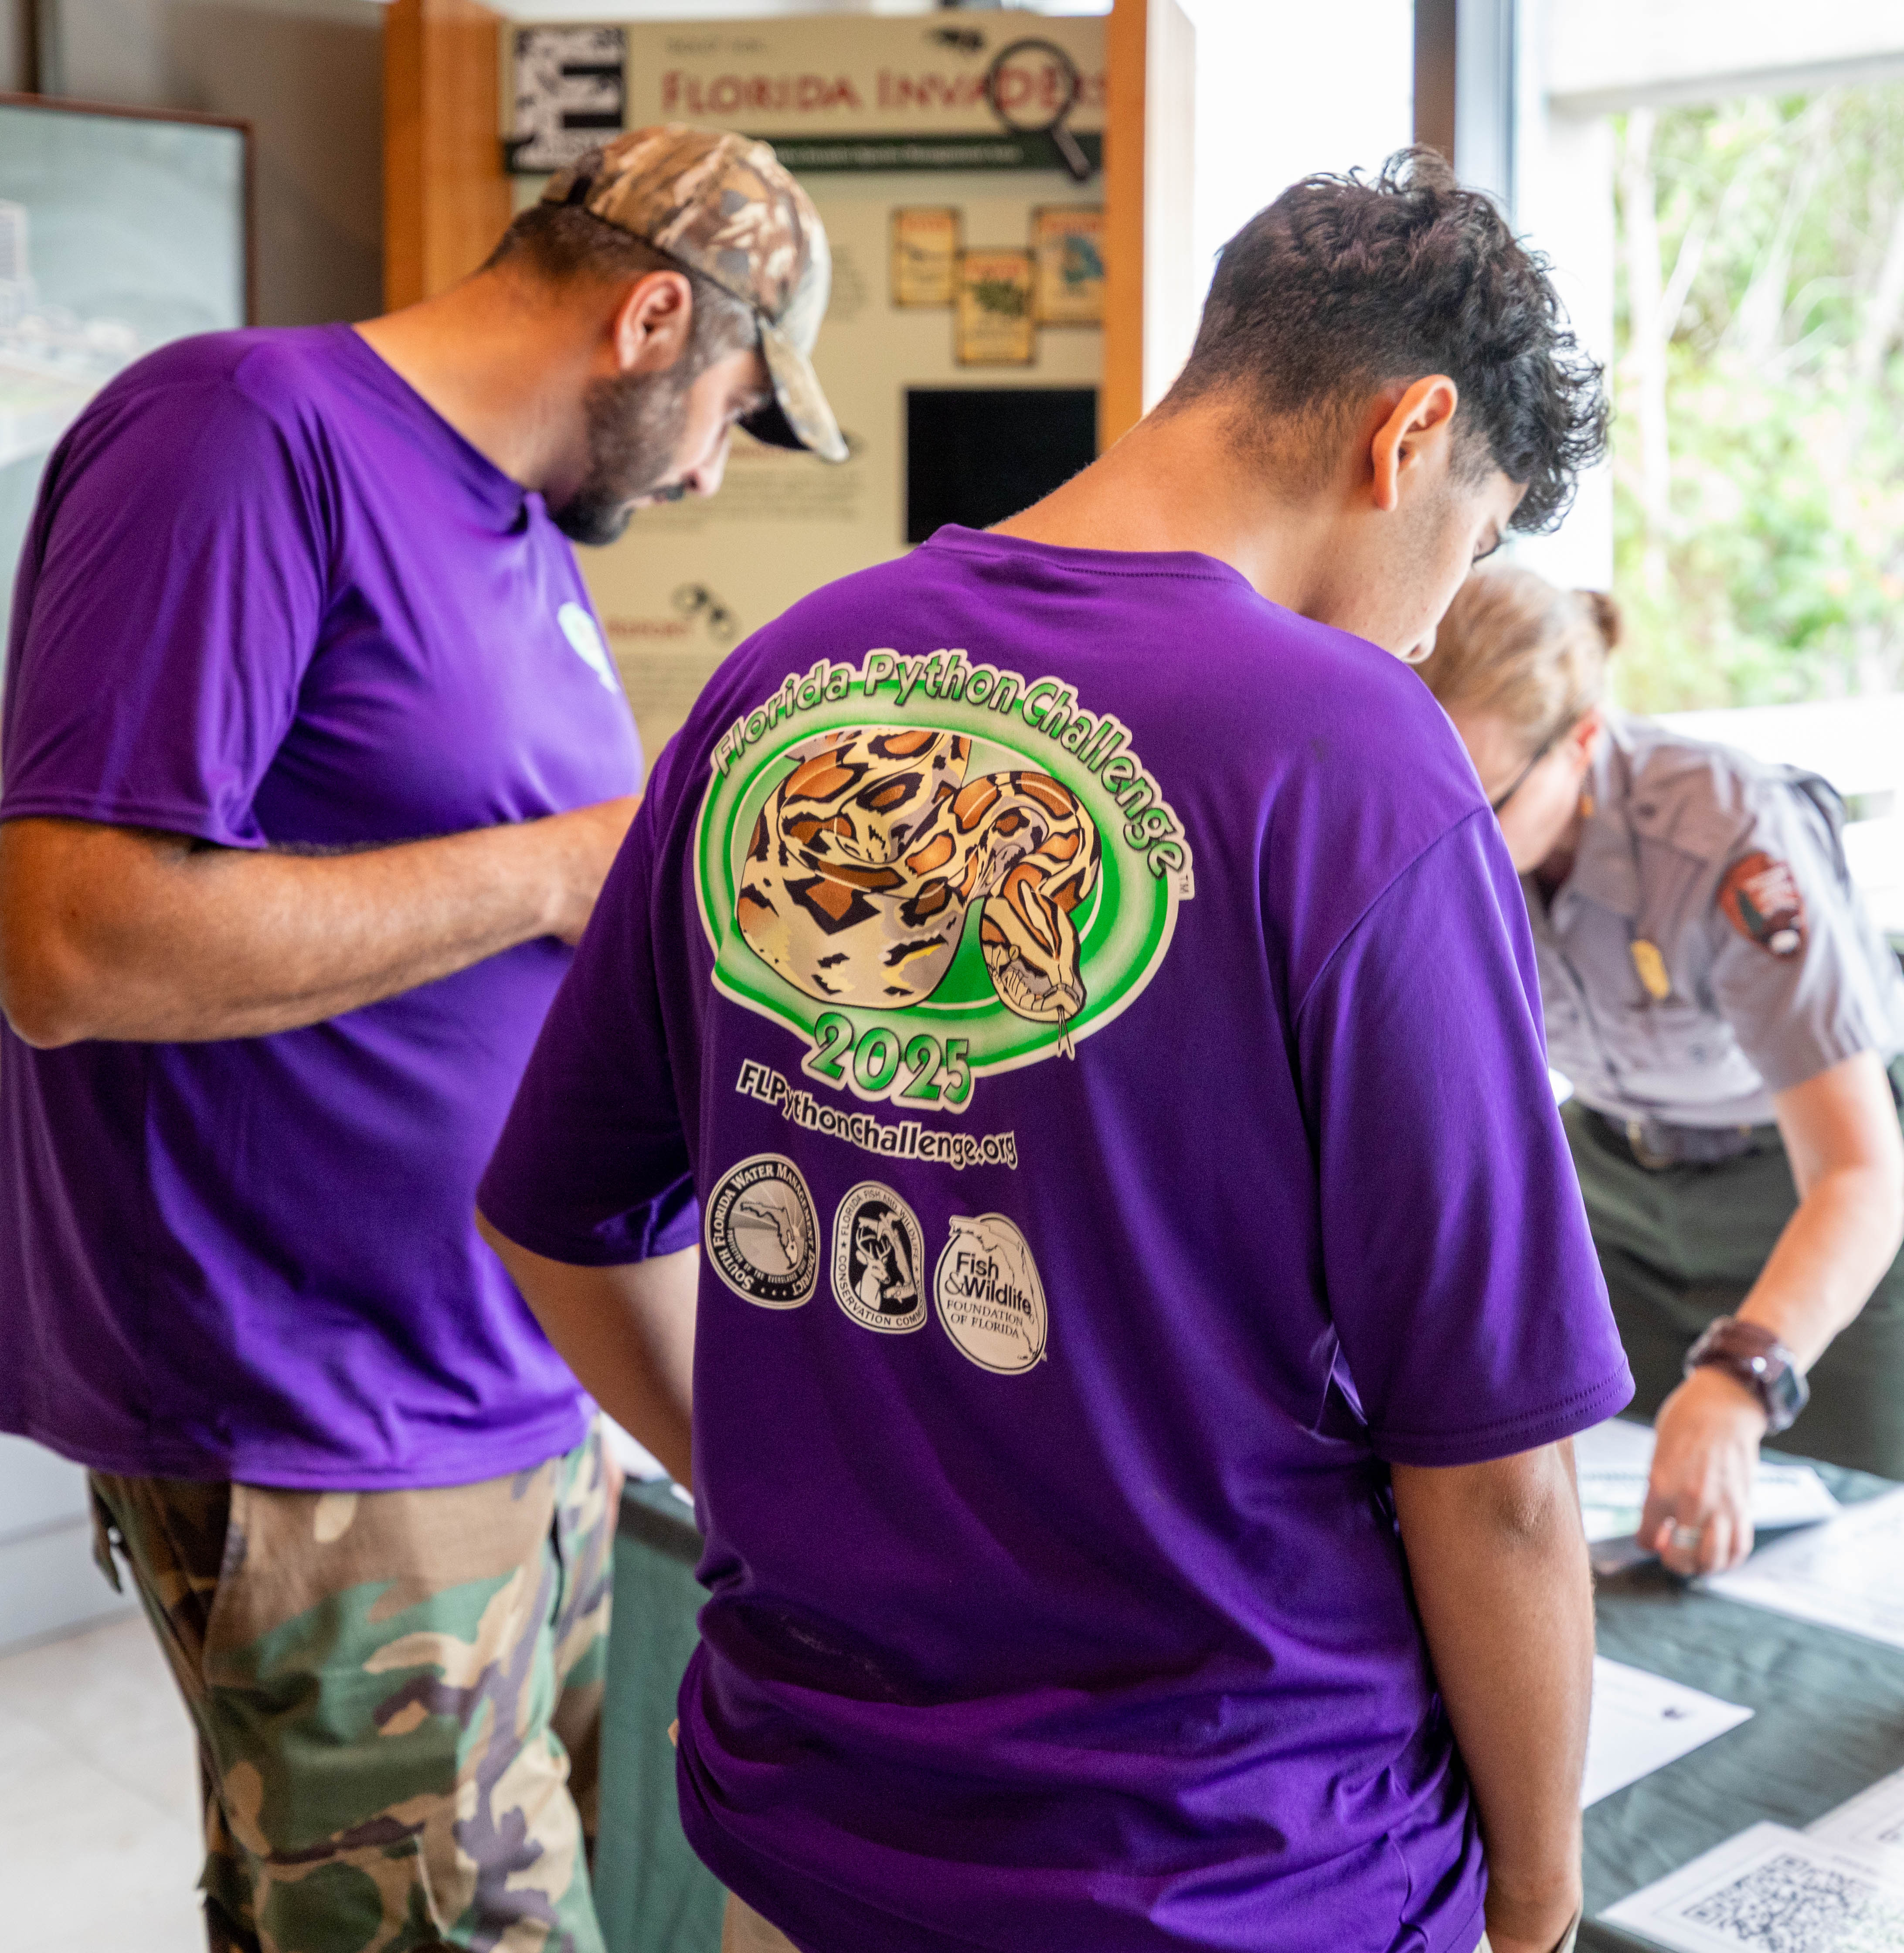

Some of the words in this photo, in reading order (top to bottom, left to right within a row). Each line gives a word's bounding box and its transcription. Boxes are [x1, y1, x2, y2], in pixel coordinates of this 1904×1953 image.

[714, 663, 850, 777] Florida
[864, 653, 1019, 714] Python
[1022, 682, 1184, 880] Challenge
[808, 1012, 971, 1104] 2025
[740, 1064, 1016, 1166] FLPythonChallenge.org
[730, 1164, 775, 1190] WATER
[713, 1188, 736, 1247] FLORIDA
[841, 1195, 861, 1236] FLORIDA
[864, 1191, 881, 1200] FISH
[882, 1195, 898, 1210] AND
[899, 1208, 919, 1260] WILDLIFE
[719, 1250, 754, 1290] SOUTH
[838, 1256, 891, 1326] CONSERVATION
[956, 1252, 999, 1280] Fish
[946, 1300, 1023, 1327] FOUNDATION
[951, 1313, 968, 1325] OF
[972, 1317, 1020, 1339] FLORIDA
